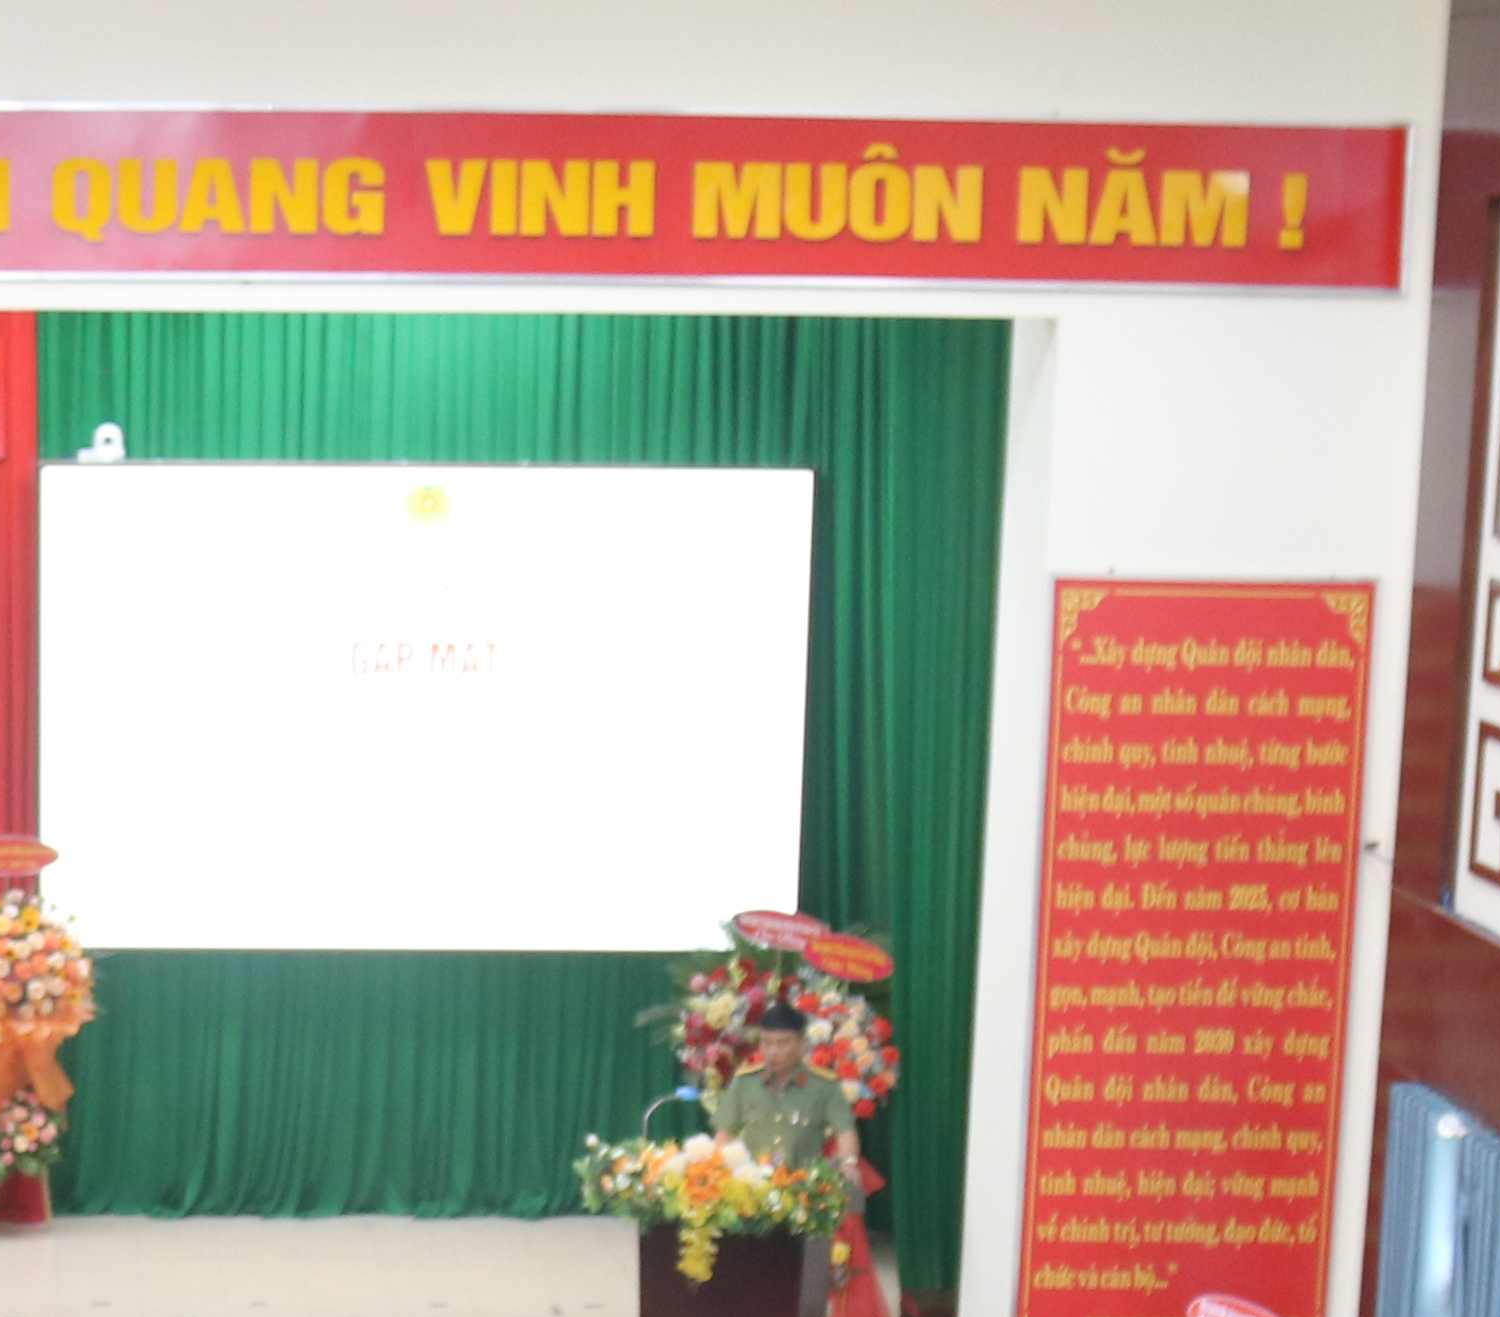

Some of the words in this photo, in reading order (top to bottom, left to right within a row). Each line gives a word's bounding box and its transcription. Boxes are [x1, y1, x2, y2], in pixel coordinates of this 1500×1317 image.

[50, 158, 385, 240] QUANG
[427, 160, 655, 238] VINH
[692, 144, 983, 243] MUÔN
[1016, 148, 1250, 248] NĂM
[1279, 173, 1305, 249] !
